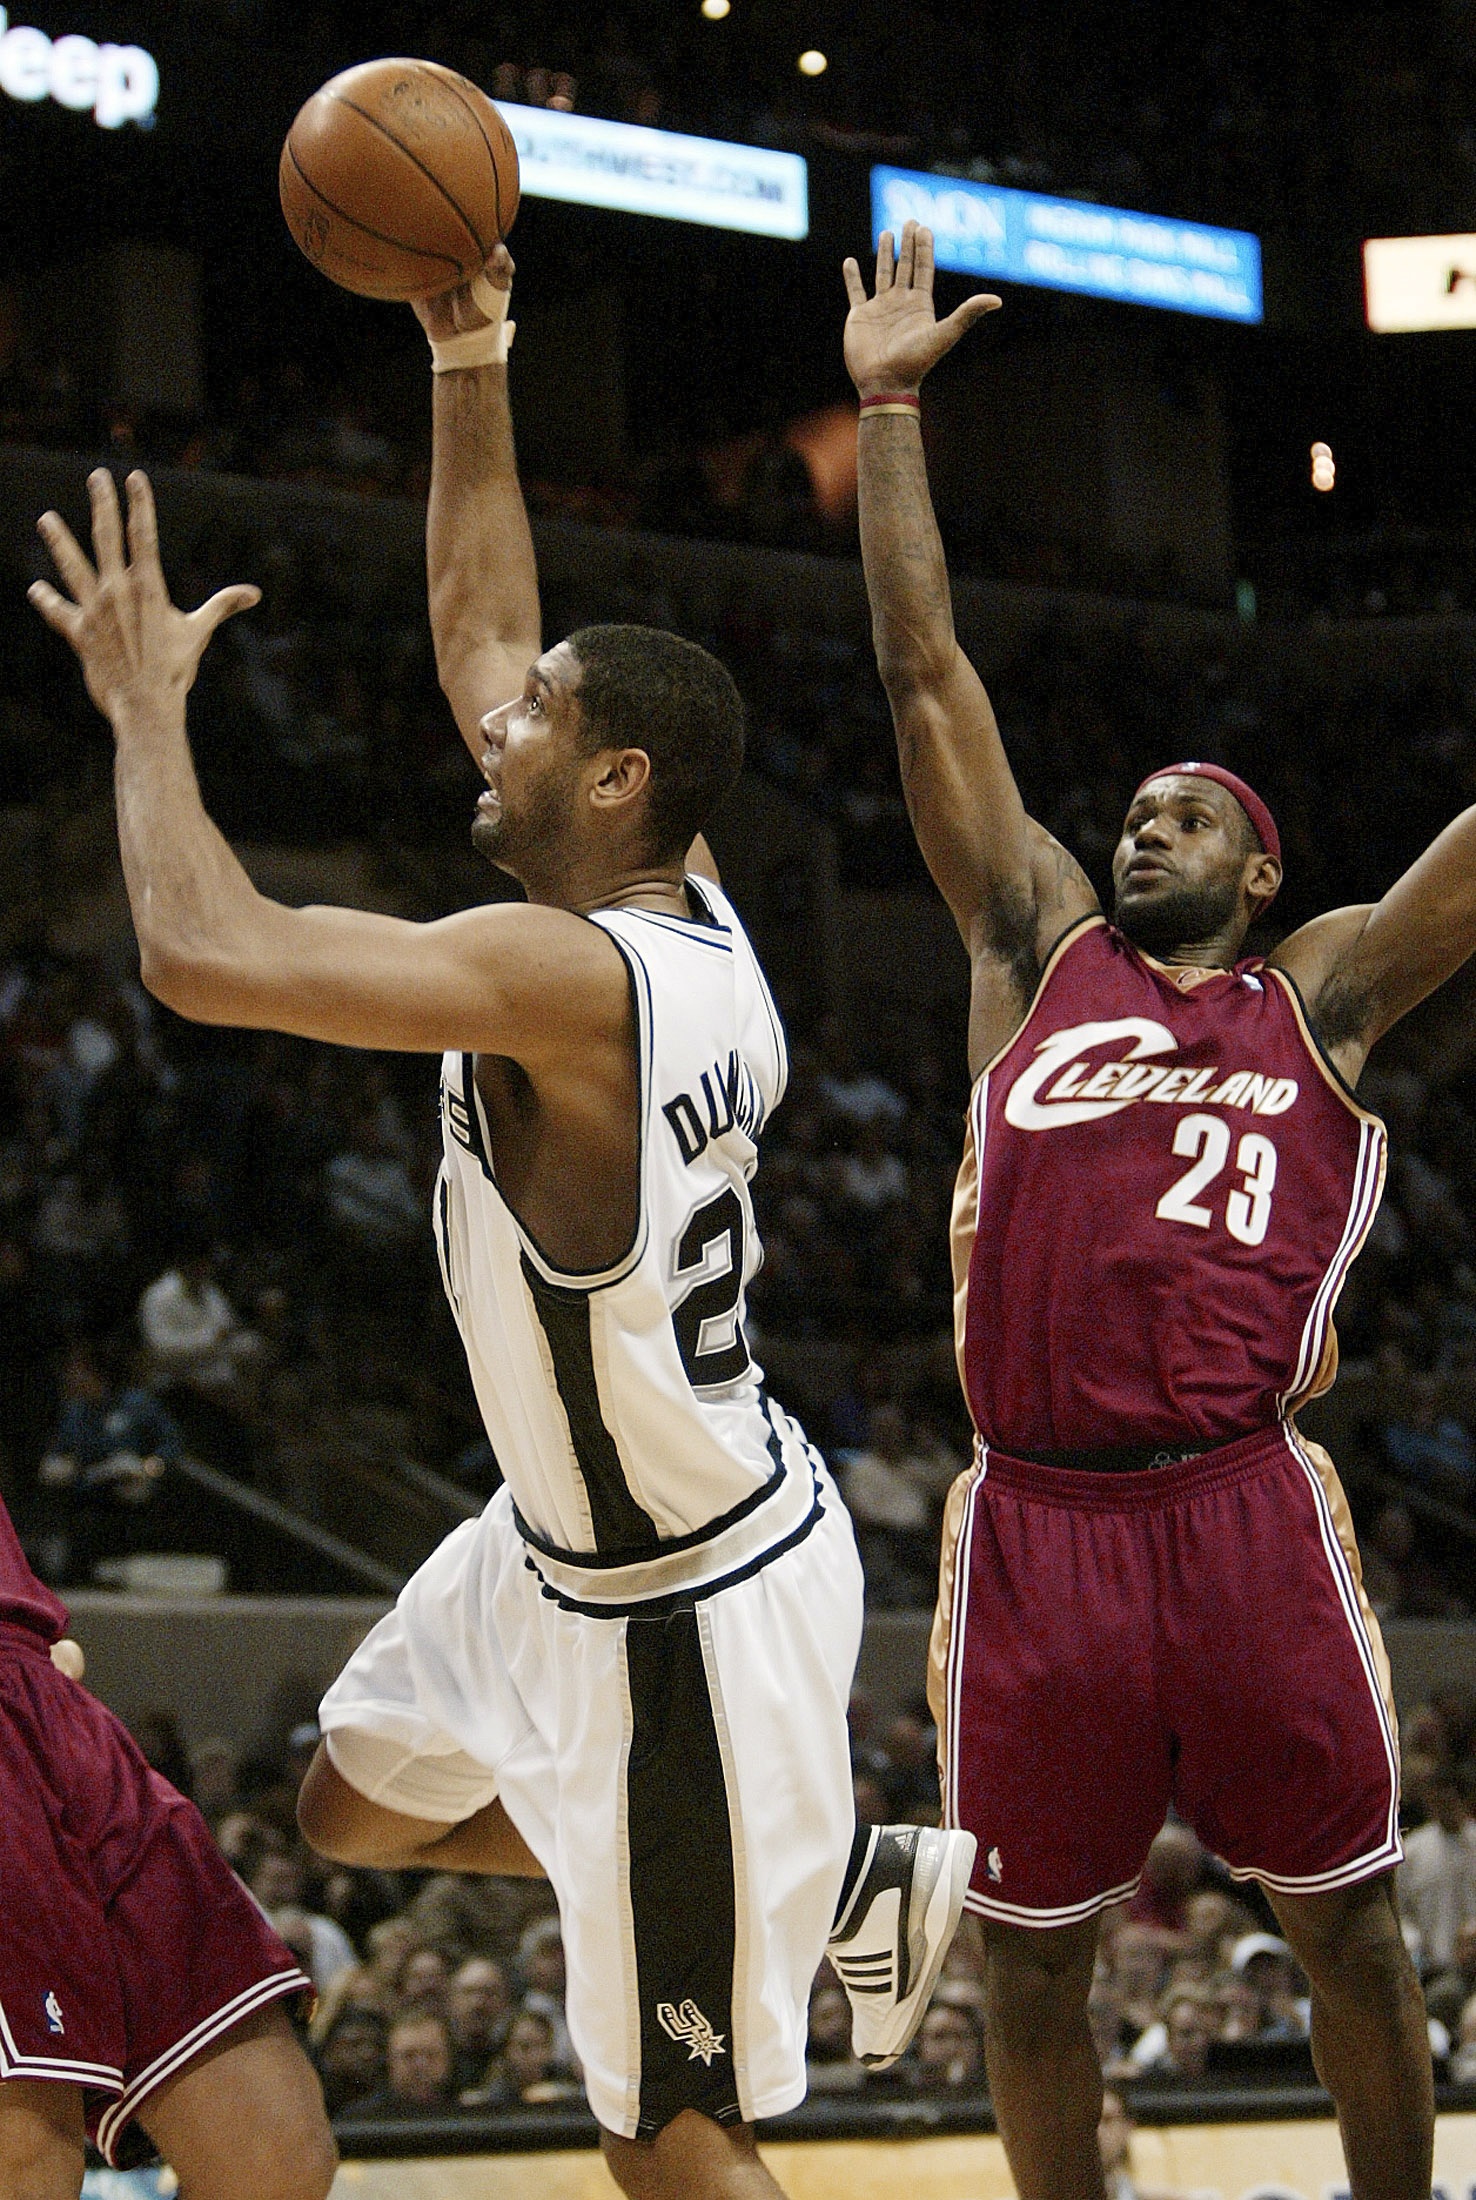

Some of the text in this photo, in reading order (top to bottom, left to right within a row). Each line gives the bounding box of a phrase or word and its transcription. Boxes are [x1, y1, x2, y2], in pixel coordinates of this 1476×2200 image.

[0, 20, 160, 129] eep
[1004, 1016, 1299, 1131] CLEVELAND
[1155, 1113, 1278, 1247] 23
